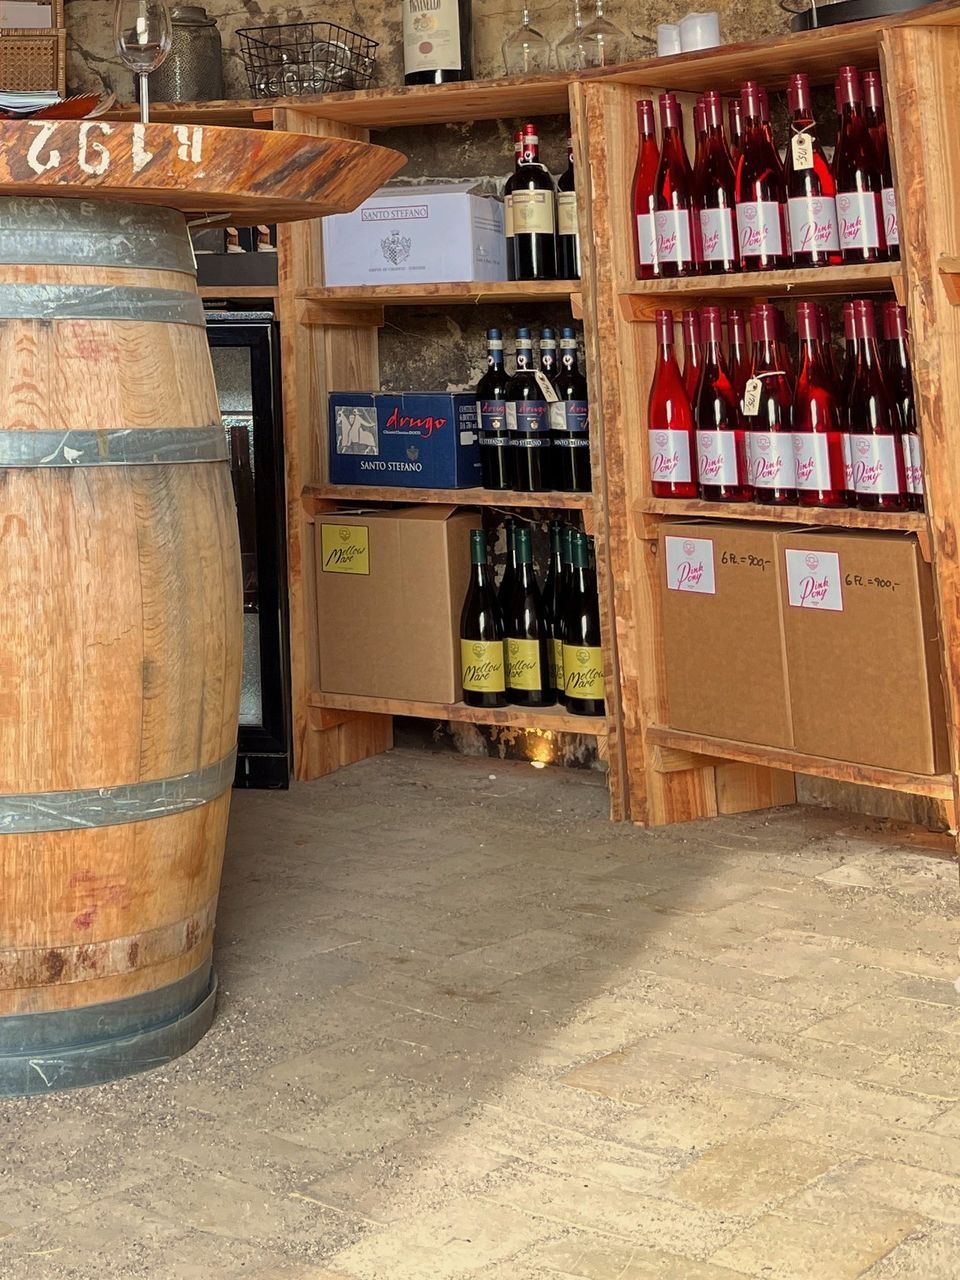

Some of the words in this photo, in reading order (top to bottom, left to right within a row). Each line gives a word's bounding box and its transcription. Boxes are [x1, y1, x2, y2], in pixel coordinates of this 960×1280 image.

[363, 209, 389, 220] SANTO
[391, 207, 426, 218] STEFANO
[386, 407, 447, 438] drugo
[361, 461, 386, 470] SANTO
[388, 462, 422, 472] STEFANO
[326, 546, 365, 564] Mellow
